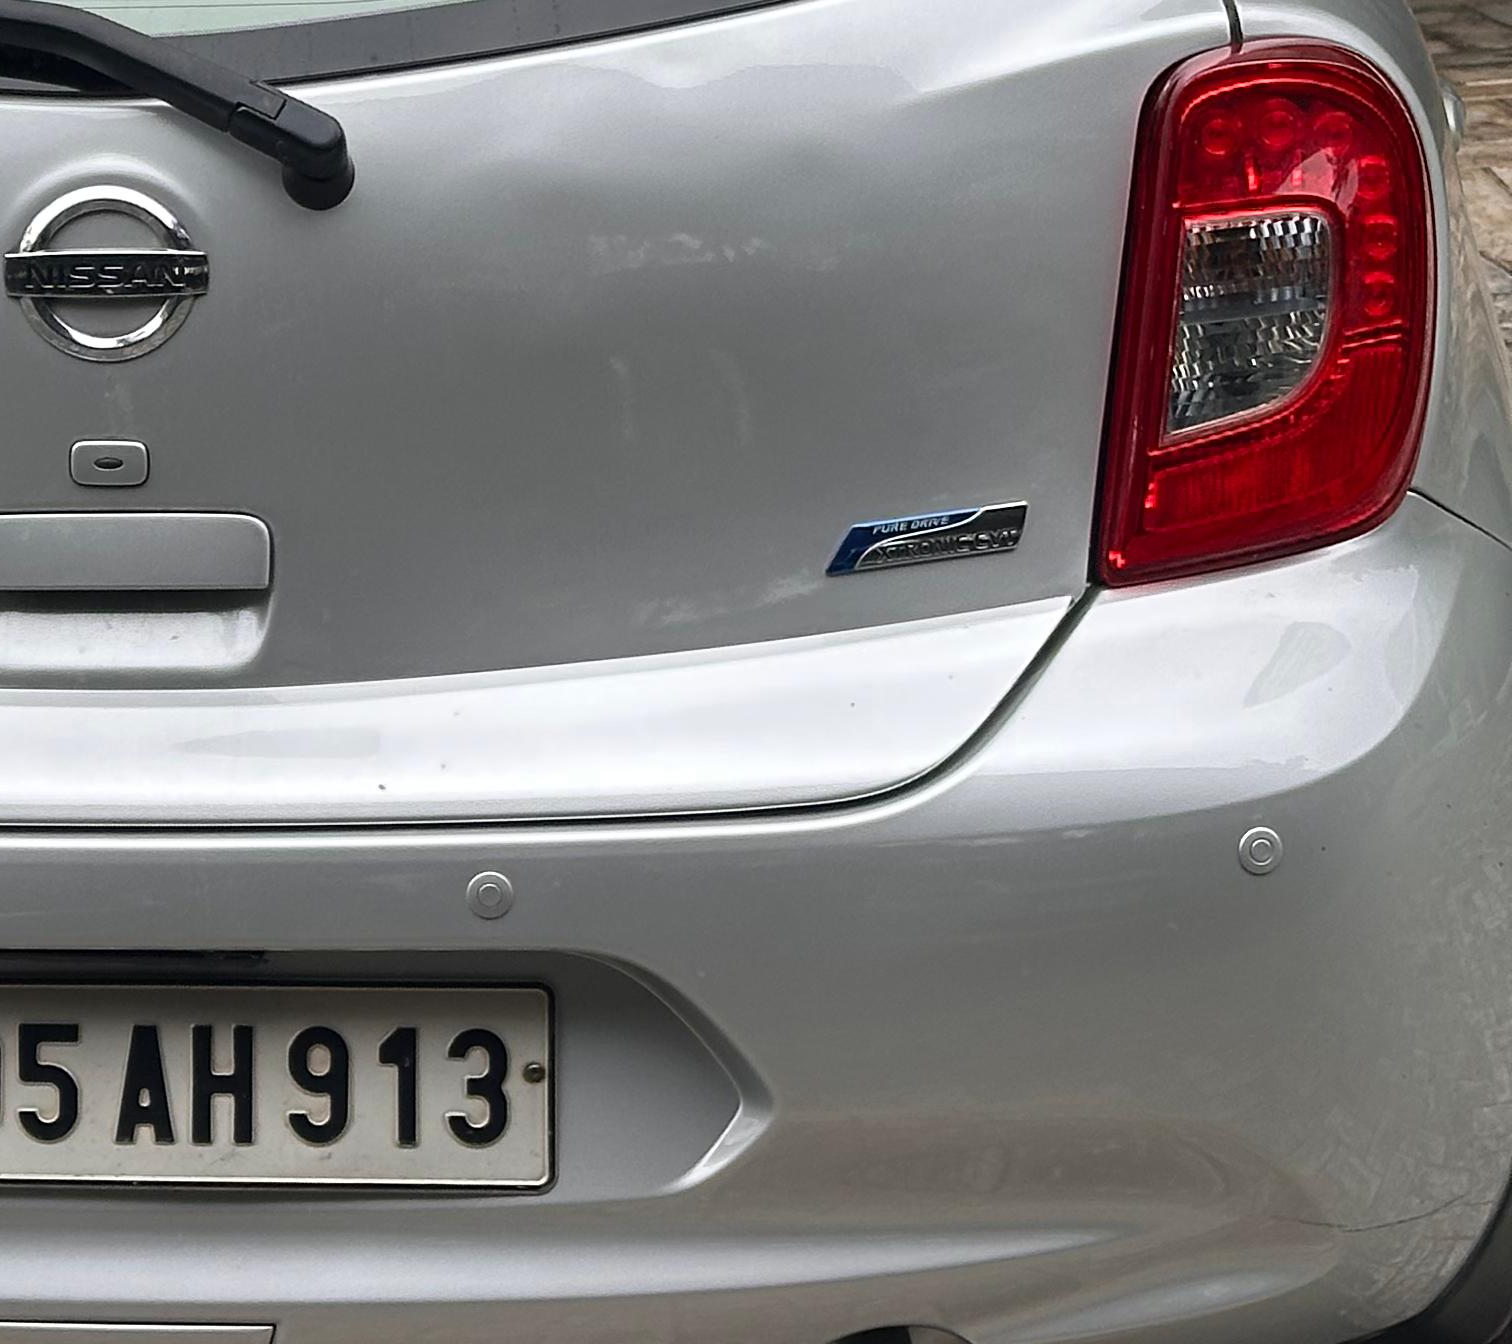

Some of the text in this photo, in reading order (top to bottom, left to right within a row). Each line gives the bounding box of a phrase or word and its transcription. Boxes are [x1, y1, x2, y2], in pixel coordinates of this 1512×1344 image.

[23, 264, 186, 289] NISSAN
[872, 515, 950, 535] PURE DRIVE
[115, 1024, 256, 1146] AH
[287, 1026, 509, 1149] 913
